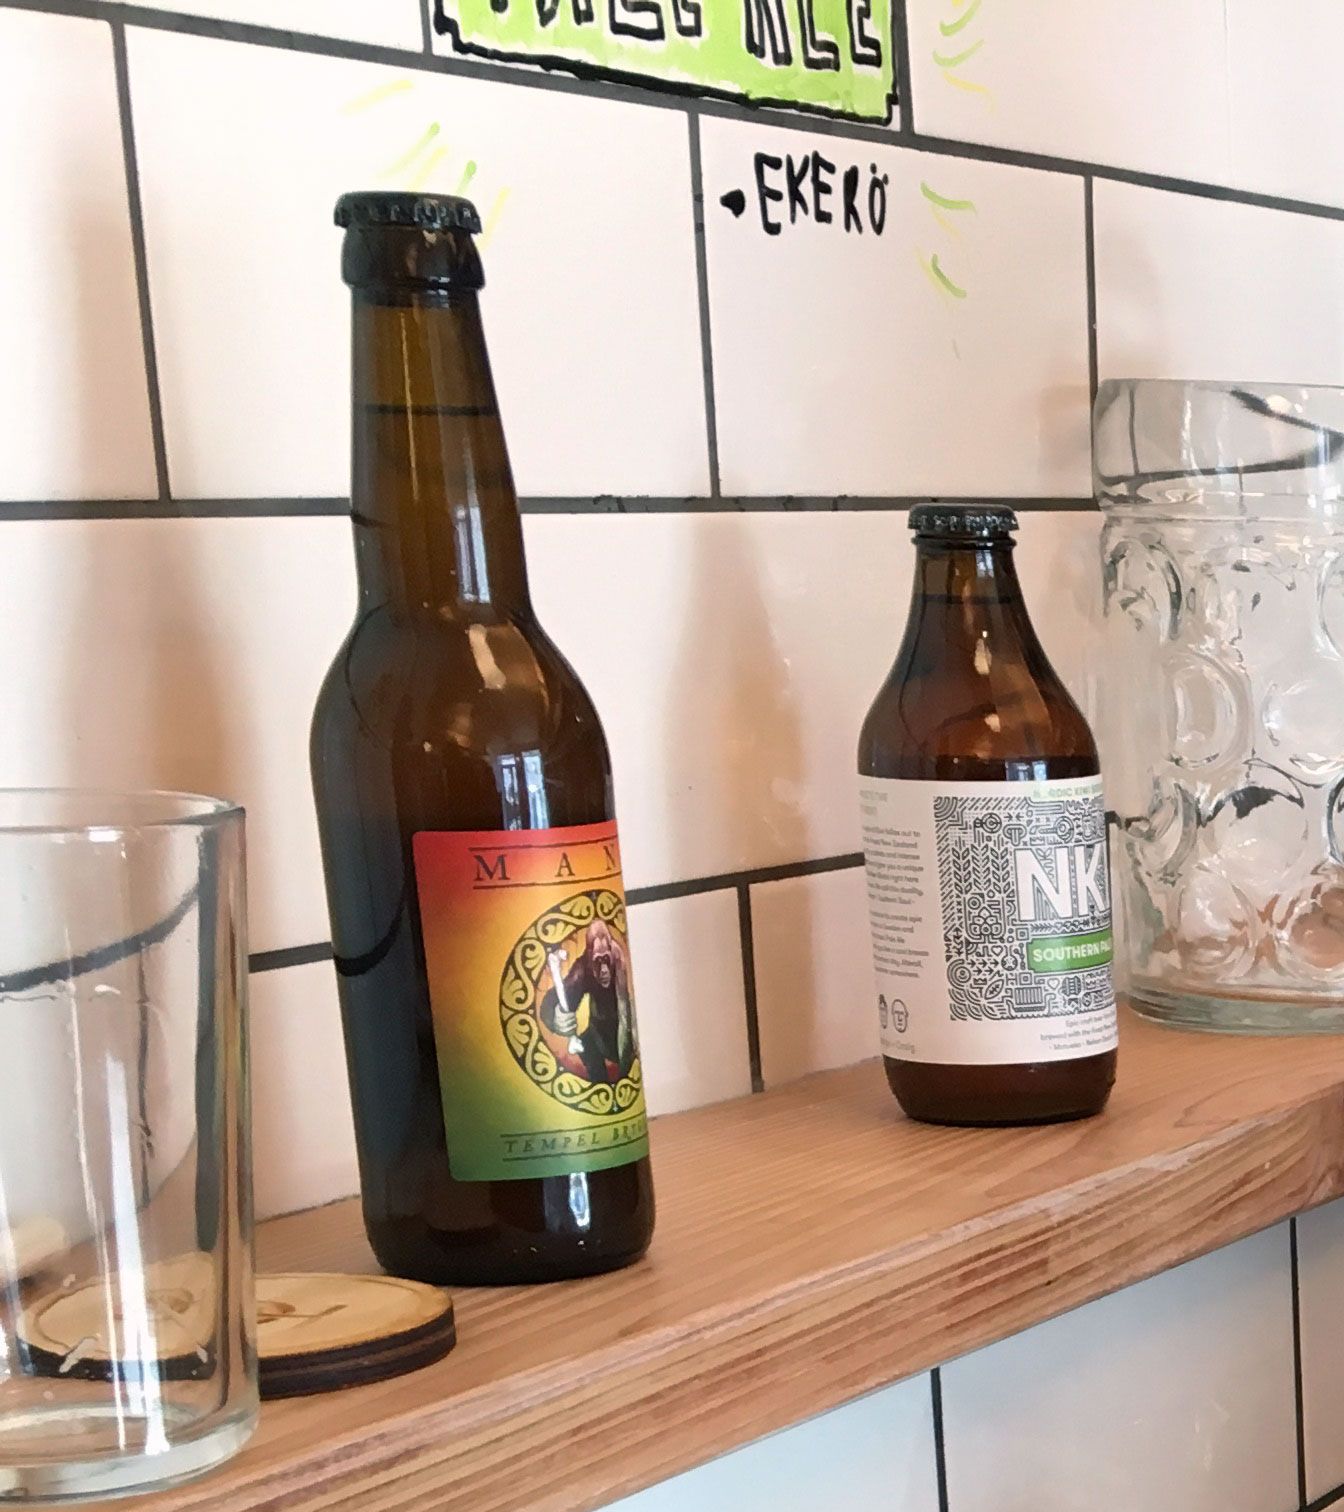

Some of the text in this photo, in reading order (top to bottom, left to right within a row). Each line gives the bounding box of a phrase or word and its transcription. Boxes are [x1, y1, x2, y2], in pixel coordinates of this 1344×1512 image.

[754, 148, 890, 236] EKERÖ
[1032, 940, 1100, 963] SOUTHERN
[503, 1131, 602, 1154] TEMPEL
